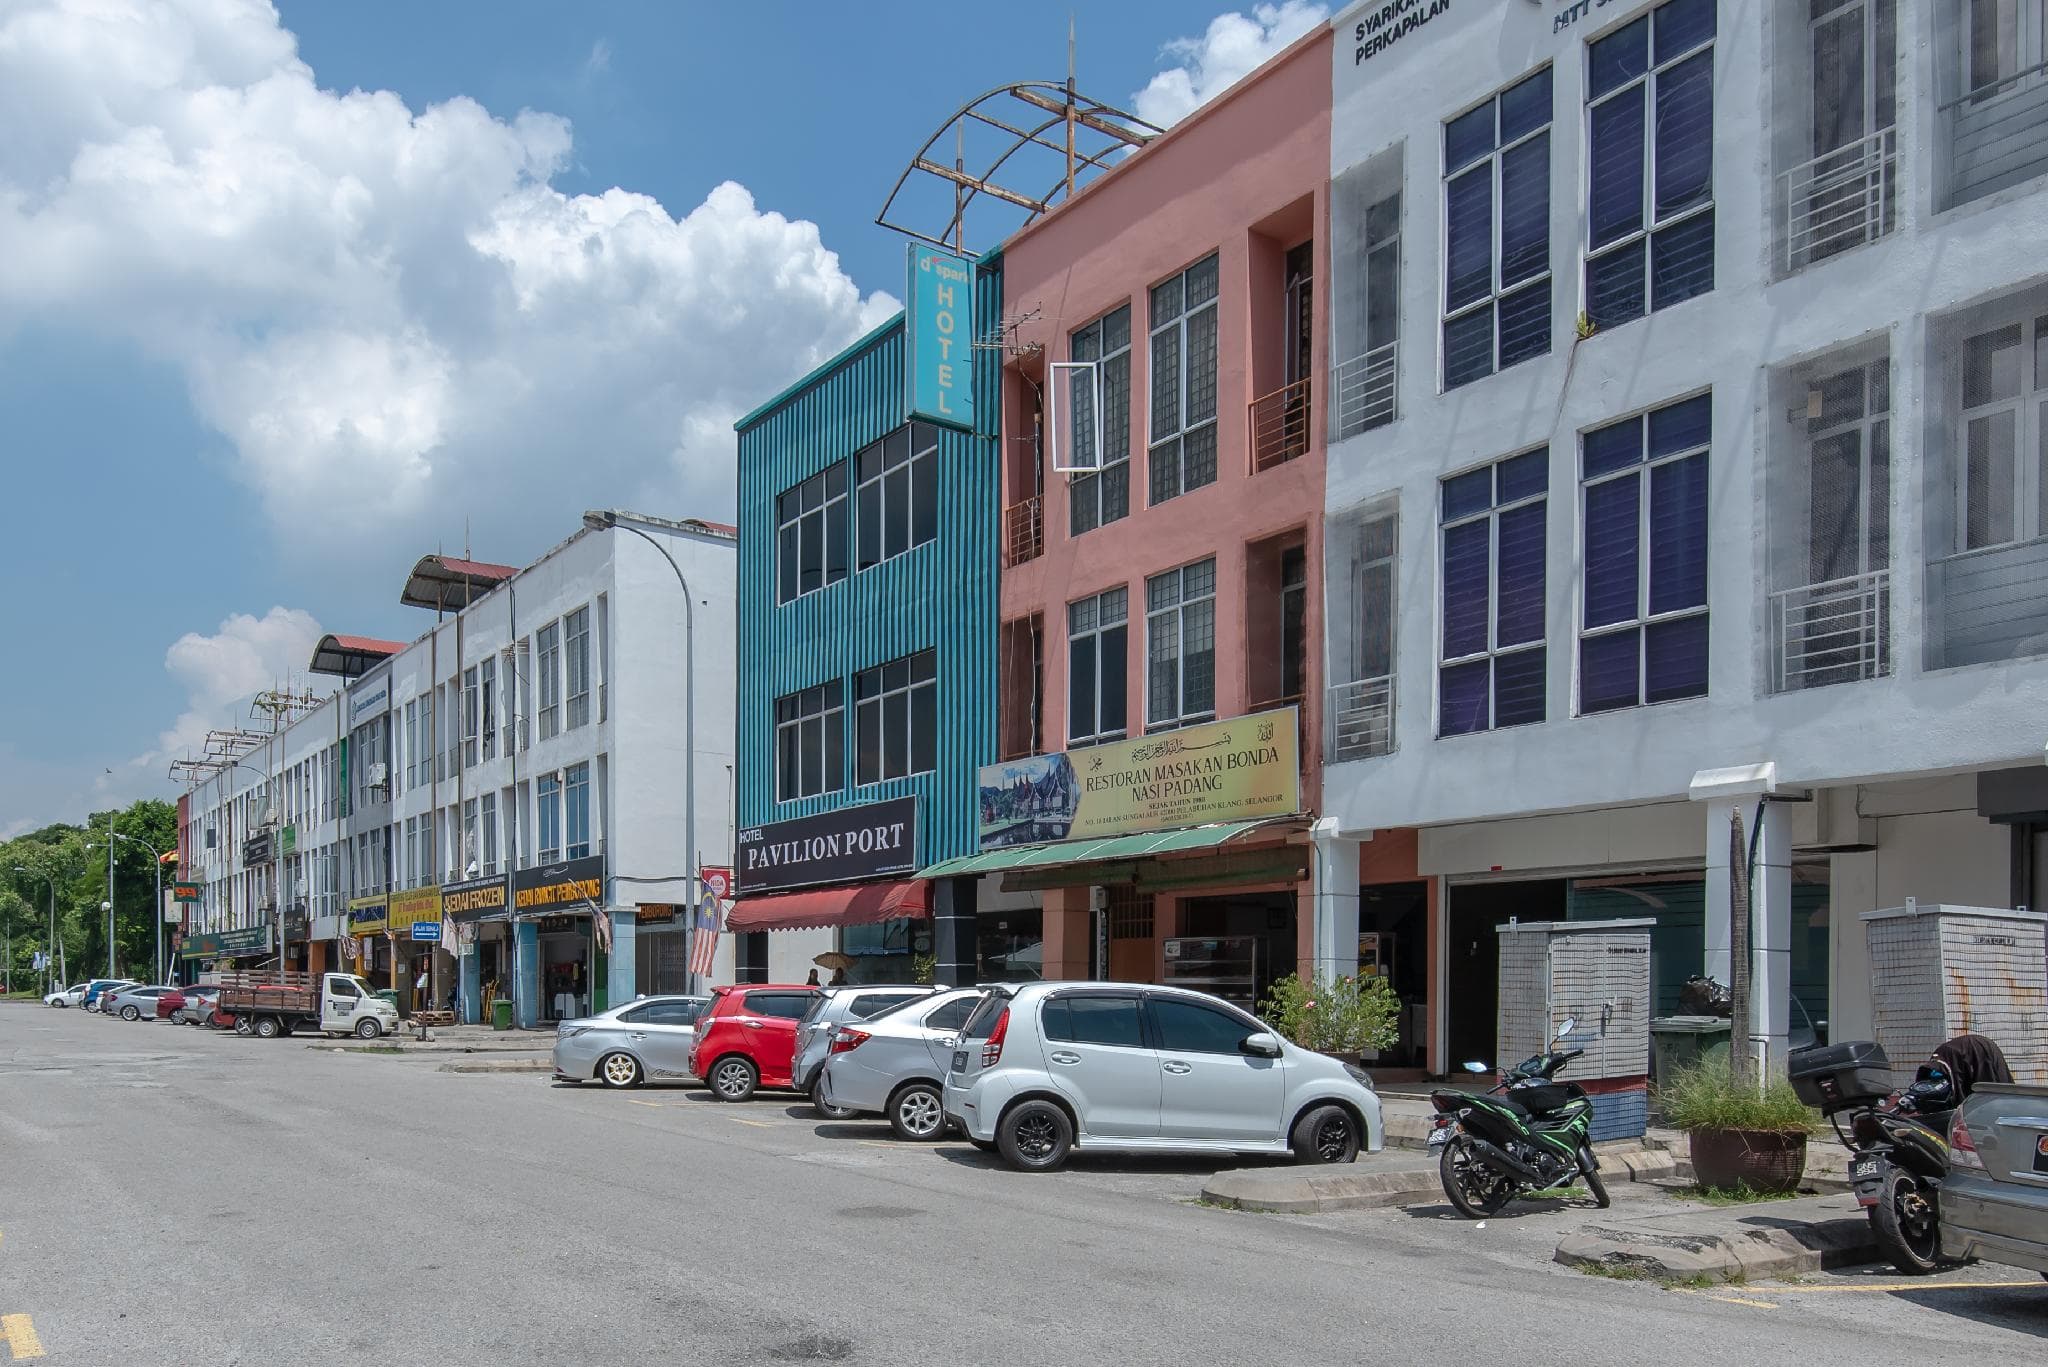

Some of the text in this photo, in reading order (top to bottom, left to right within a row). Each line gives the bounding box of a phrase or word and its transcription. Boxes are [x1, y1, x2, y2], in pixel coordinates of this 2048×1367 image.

[1355, 0, 1419, 41] SYARIKA
[1355, 0, 1450, 65] PERKAPALAN
[936, 282, 954, 414] HOTEL
[1086, 746, 1279, 792] RESTORAN MASAKAN BONDA
[1132, 774, 1222, 802] NASI PADANG
[1149, 801, 1169, 809] SEJAK
[1170, 798, 1191, 806] TAHUN
[739, 828, 764, 844] HOTEL
[747, 822, 905, 870] PAVILION PORT
[445, 891, 469, 913] KEDAI
[469, 885, 505, 909] FROZEN
